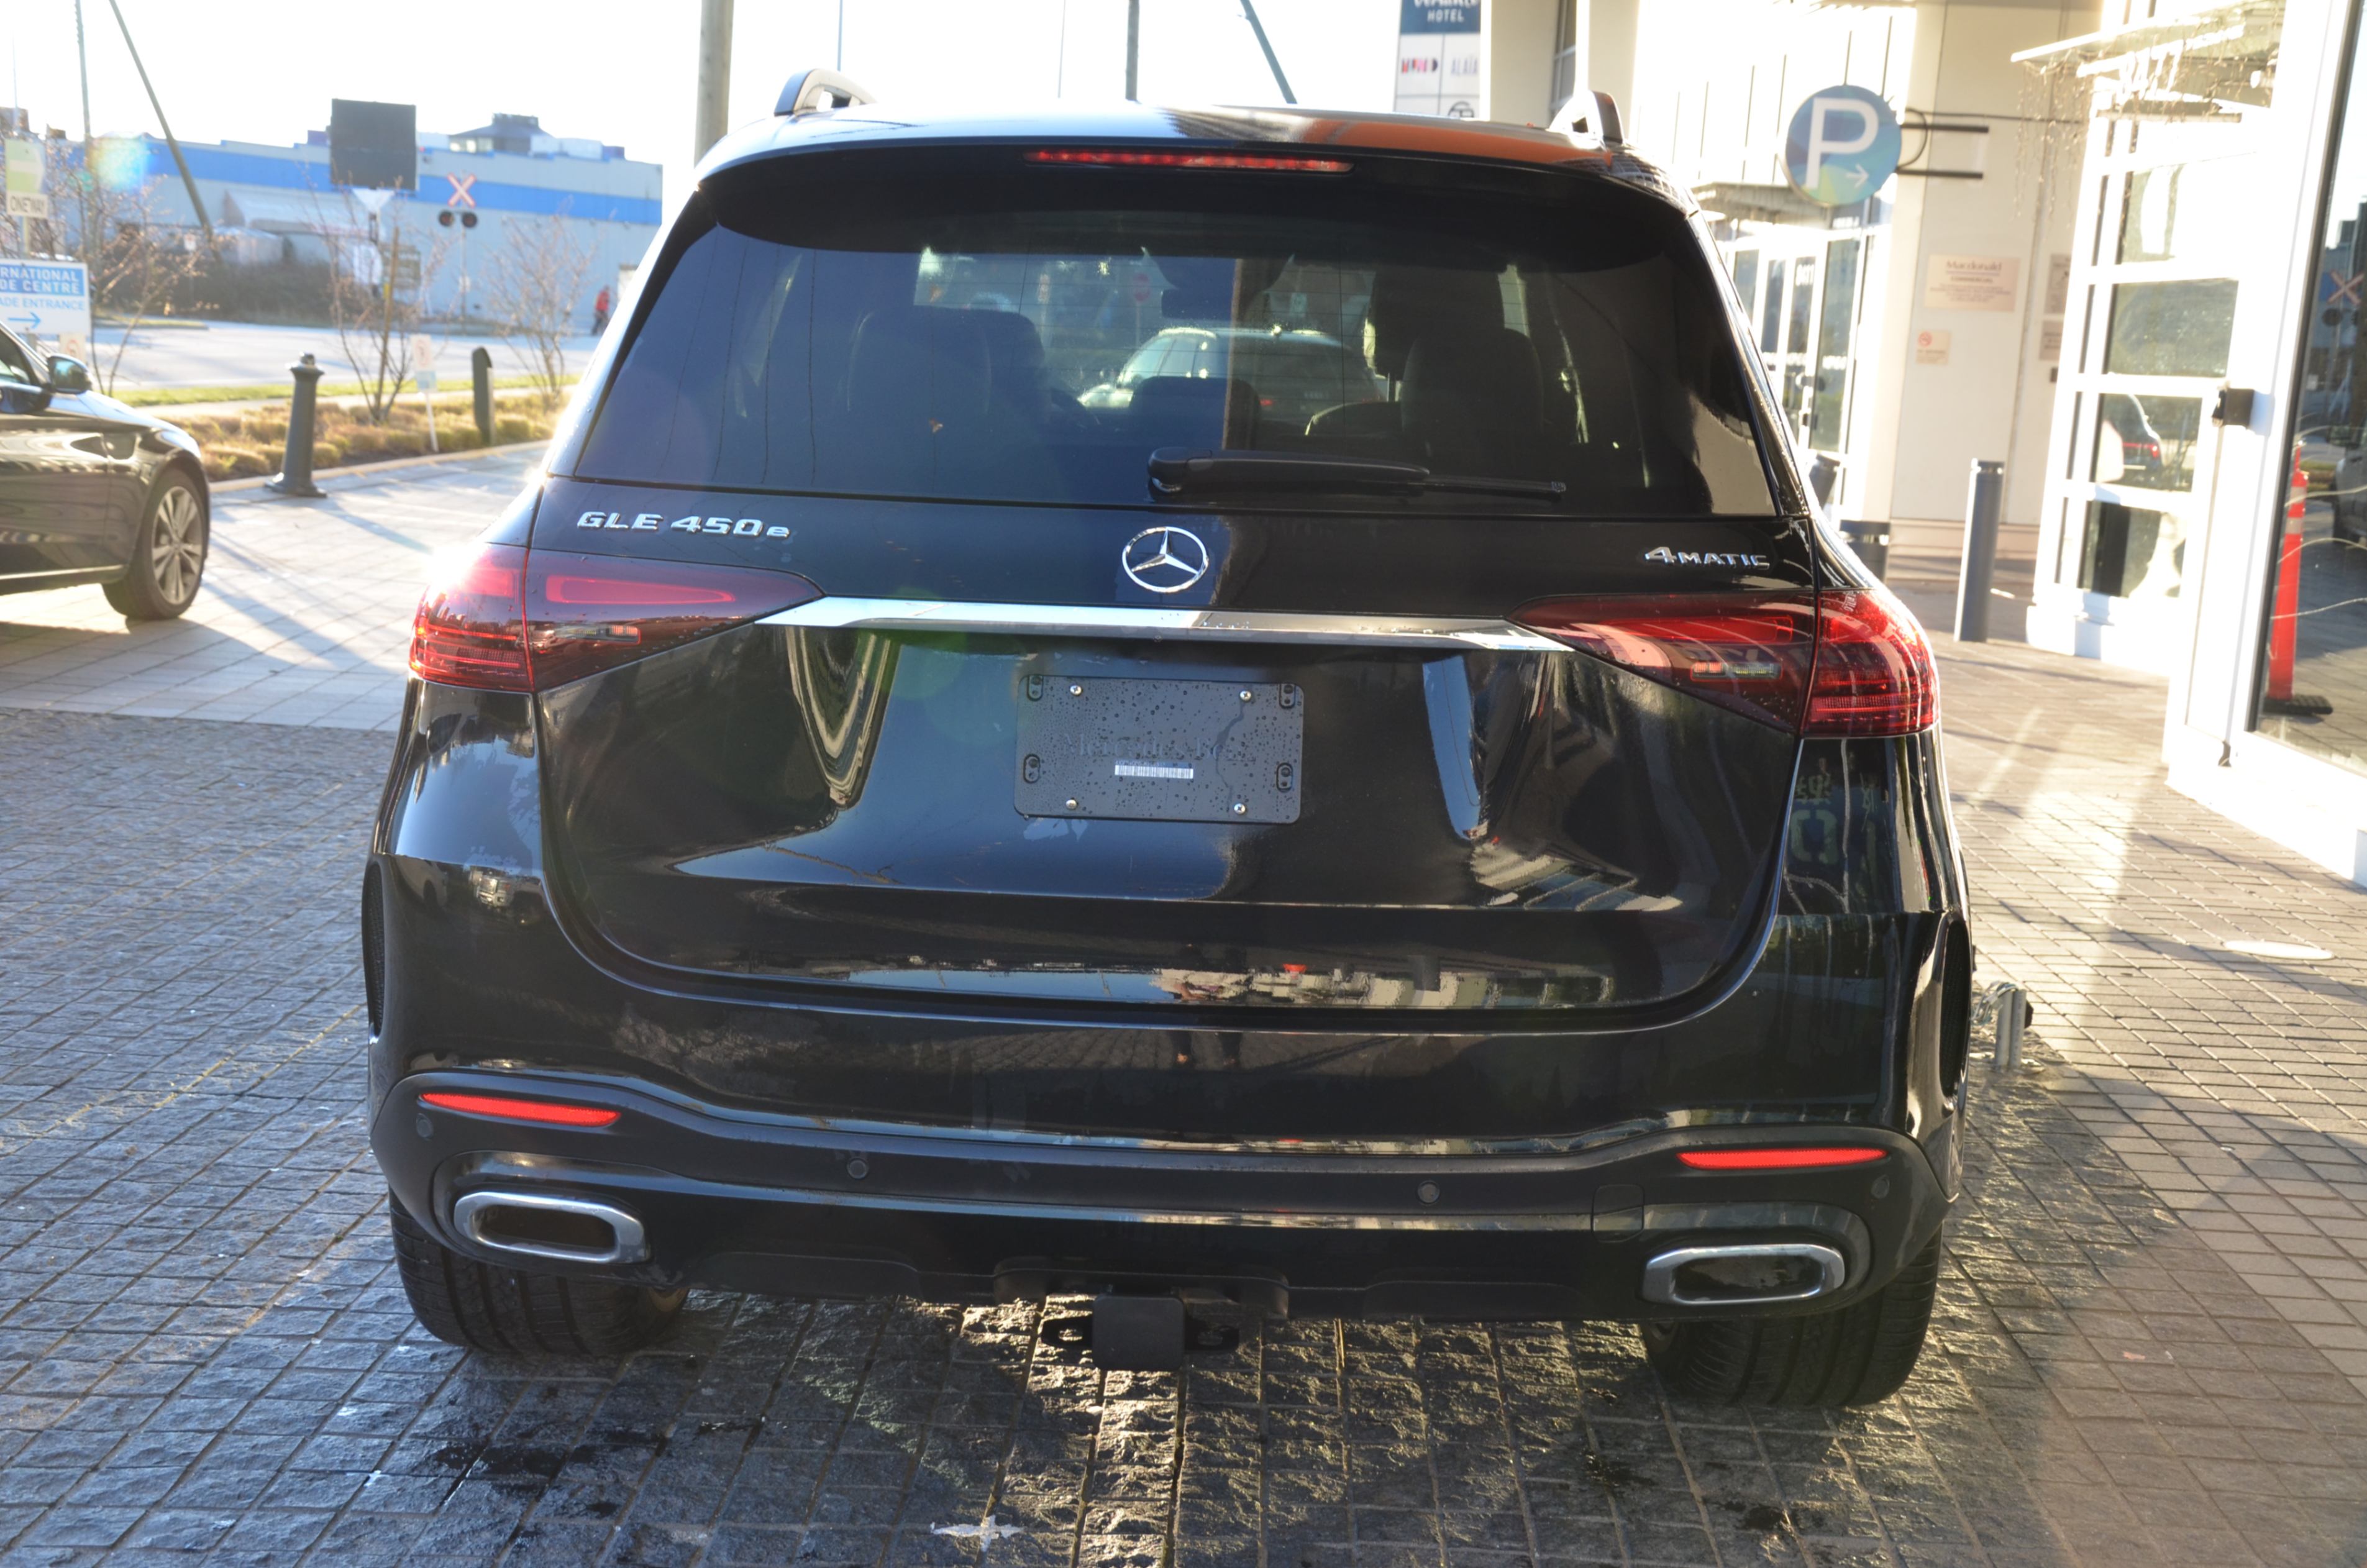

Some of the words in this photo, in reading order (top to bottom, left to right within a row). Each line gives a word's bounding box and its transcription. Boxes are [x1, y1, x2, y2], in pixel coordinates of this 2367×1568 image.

[1427, 9, 1464, 23] HOTEL
[1805, 97, 1879, 190] P
[1946, 260, 2002, 271] Macdonald
[22, 279, 80, 294] CENTRE
[22, 298, 84, 311] ENTRANCE
[577, 511, 664, 531] GLE
[1644, 546, 1770, 570] 4MATIC
